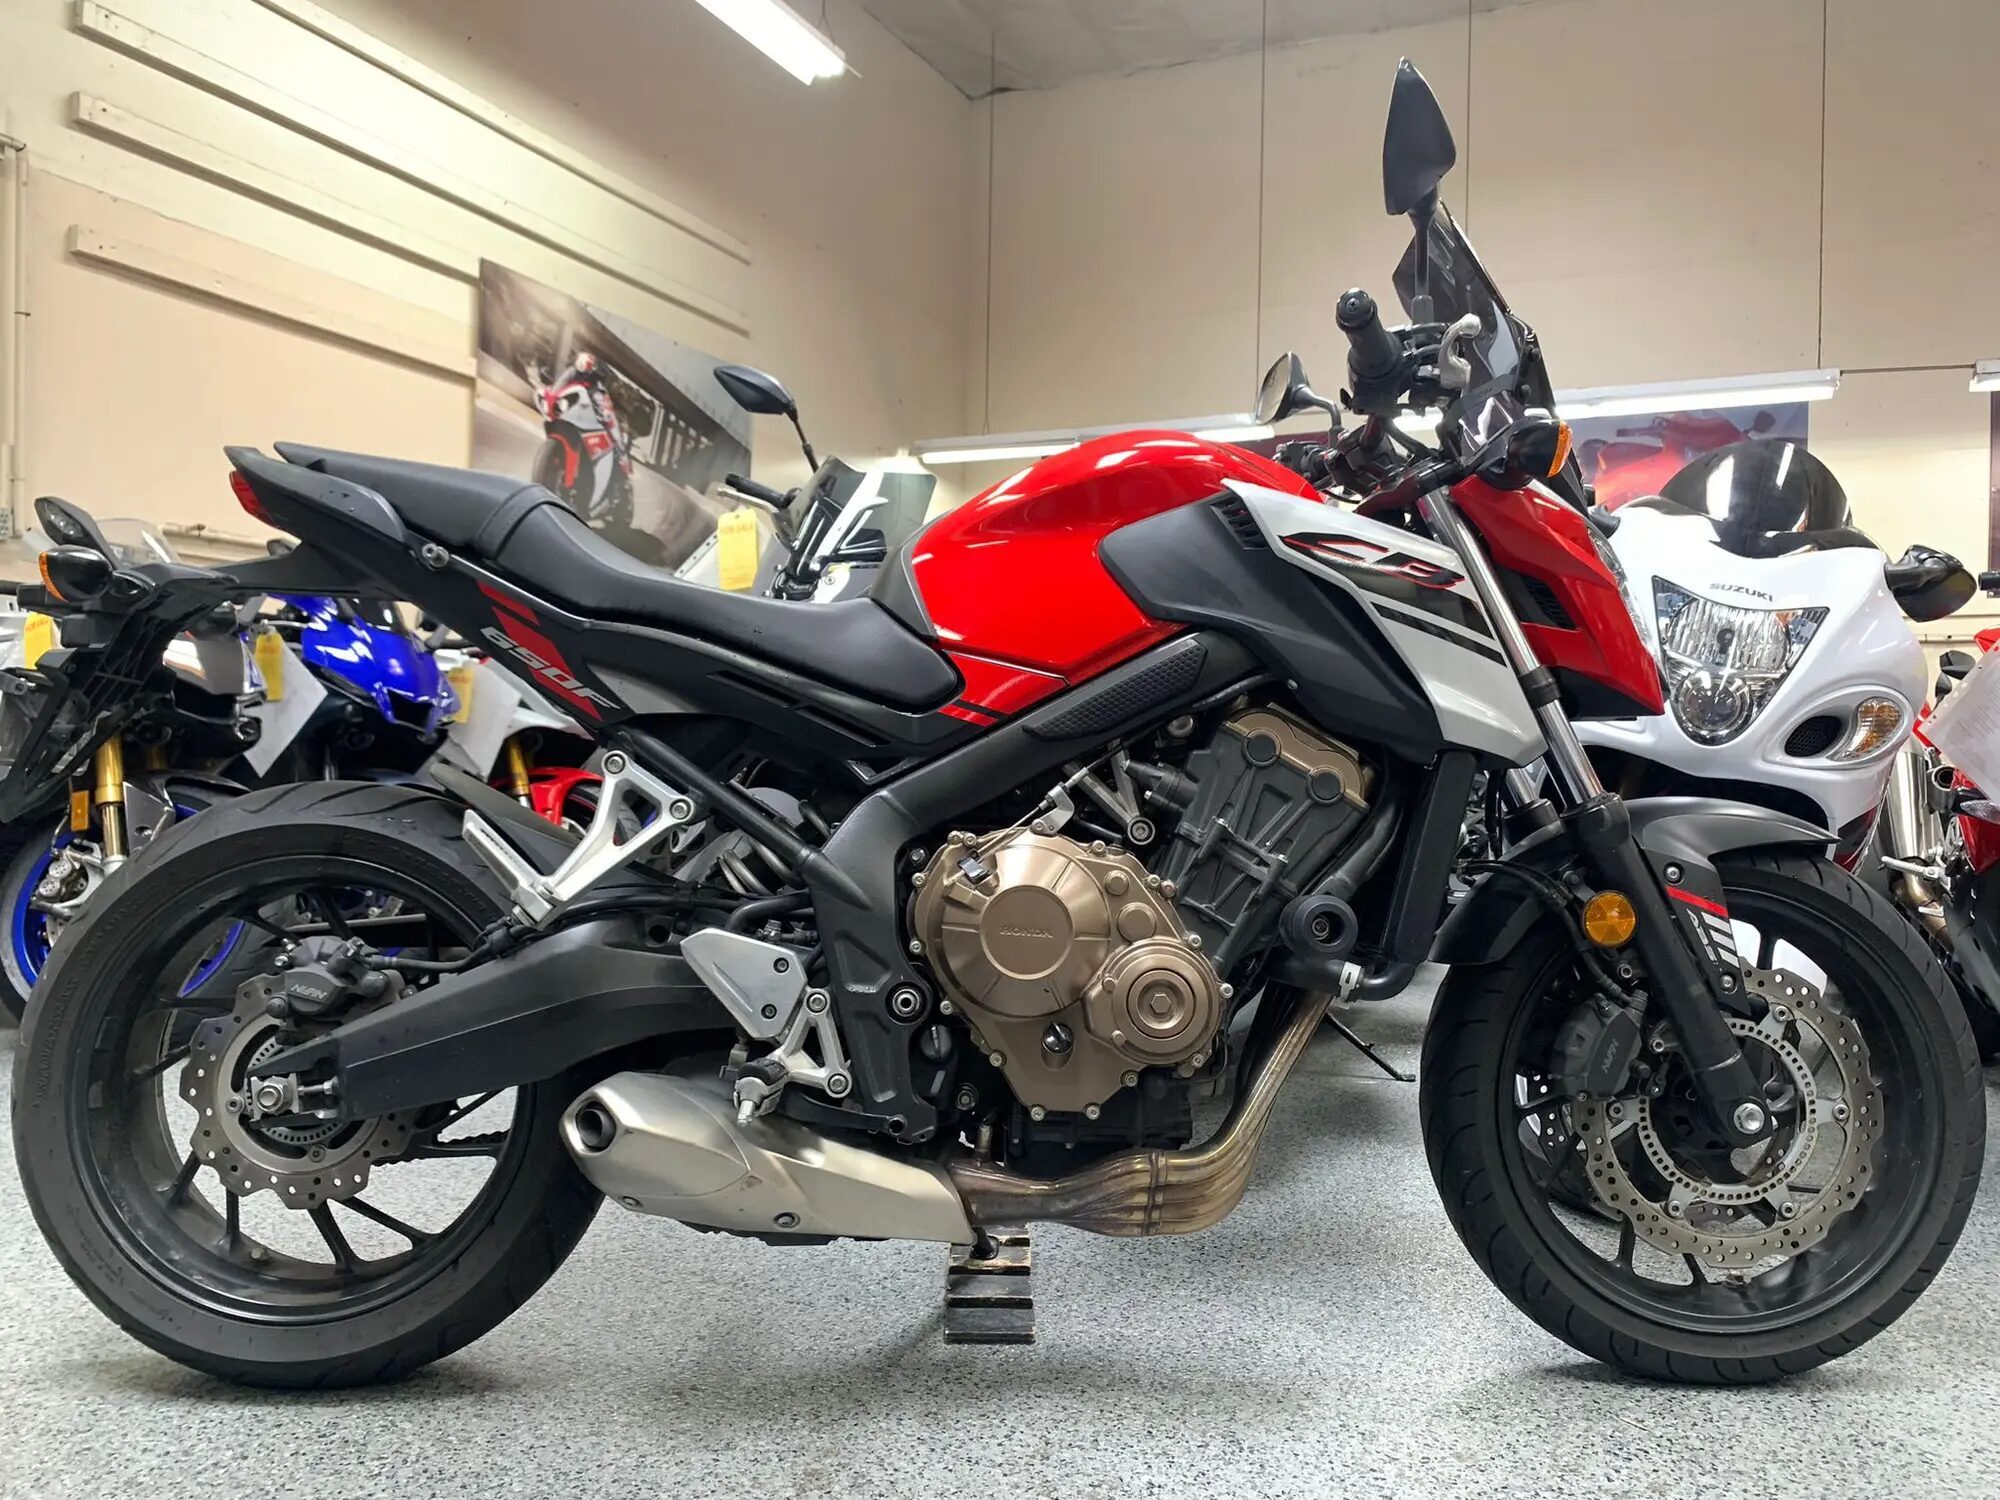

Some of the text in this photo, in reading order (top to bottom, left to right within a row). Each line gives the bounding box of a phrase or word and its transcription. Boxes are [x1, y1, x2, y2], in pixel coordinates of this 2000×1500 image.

[1279, 531, 1466, 590] CB
[1709, 583, 1773, 602] SUZUKI
[480, 626, 621, 709] 650F
[999, 926, 1054, 939] HONDA
